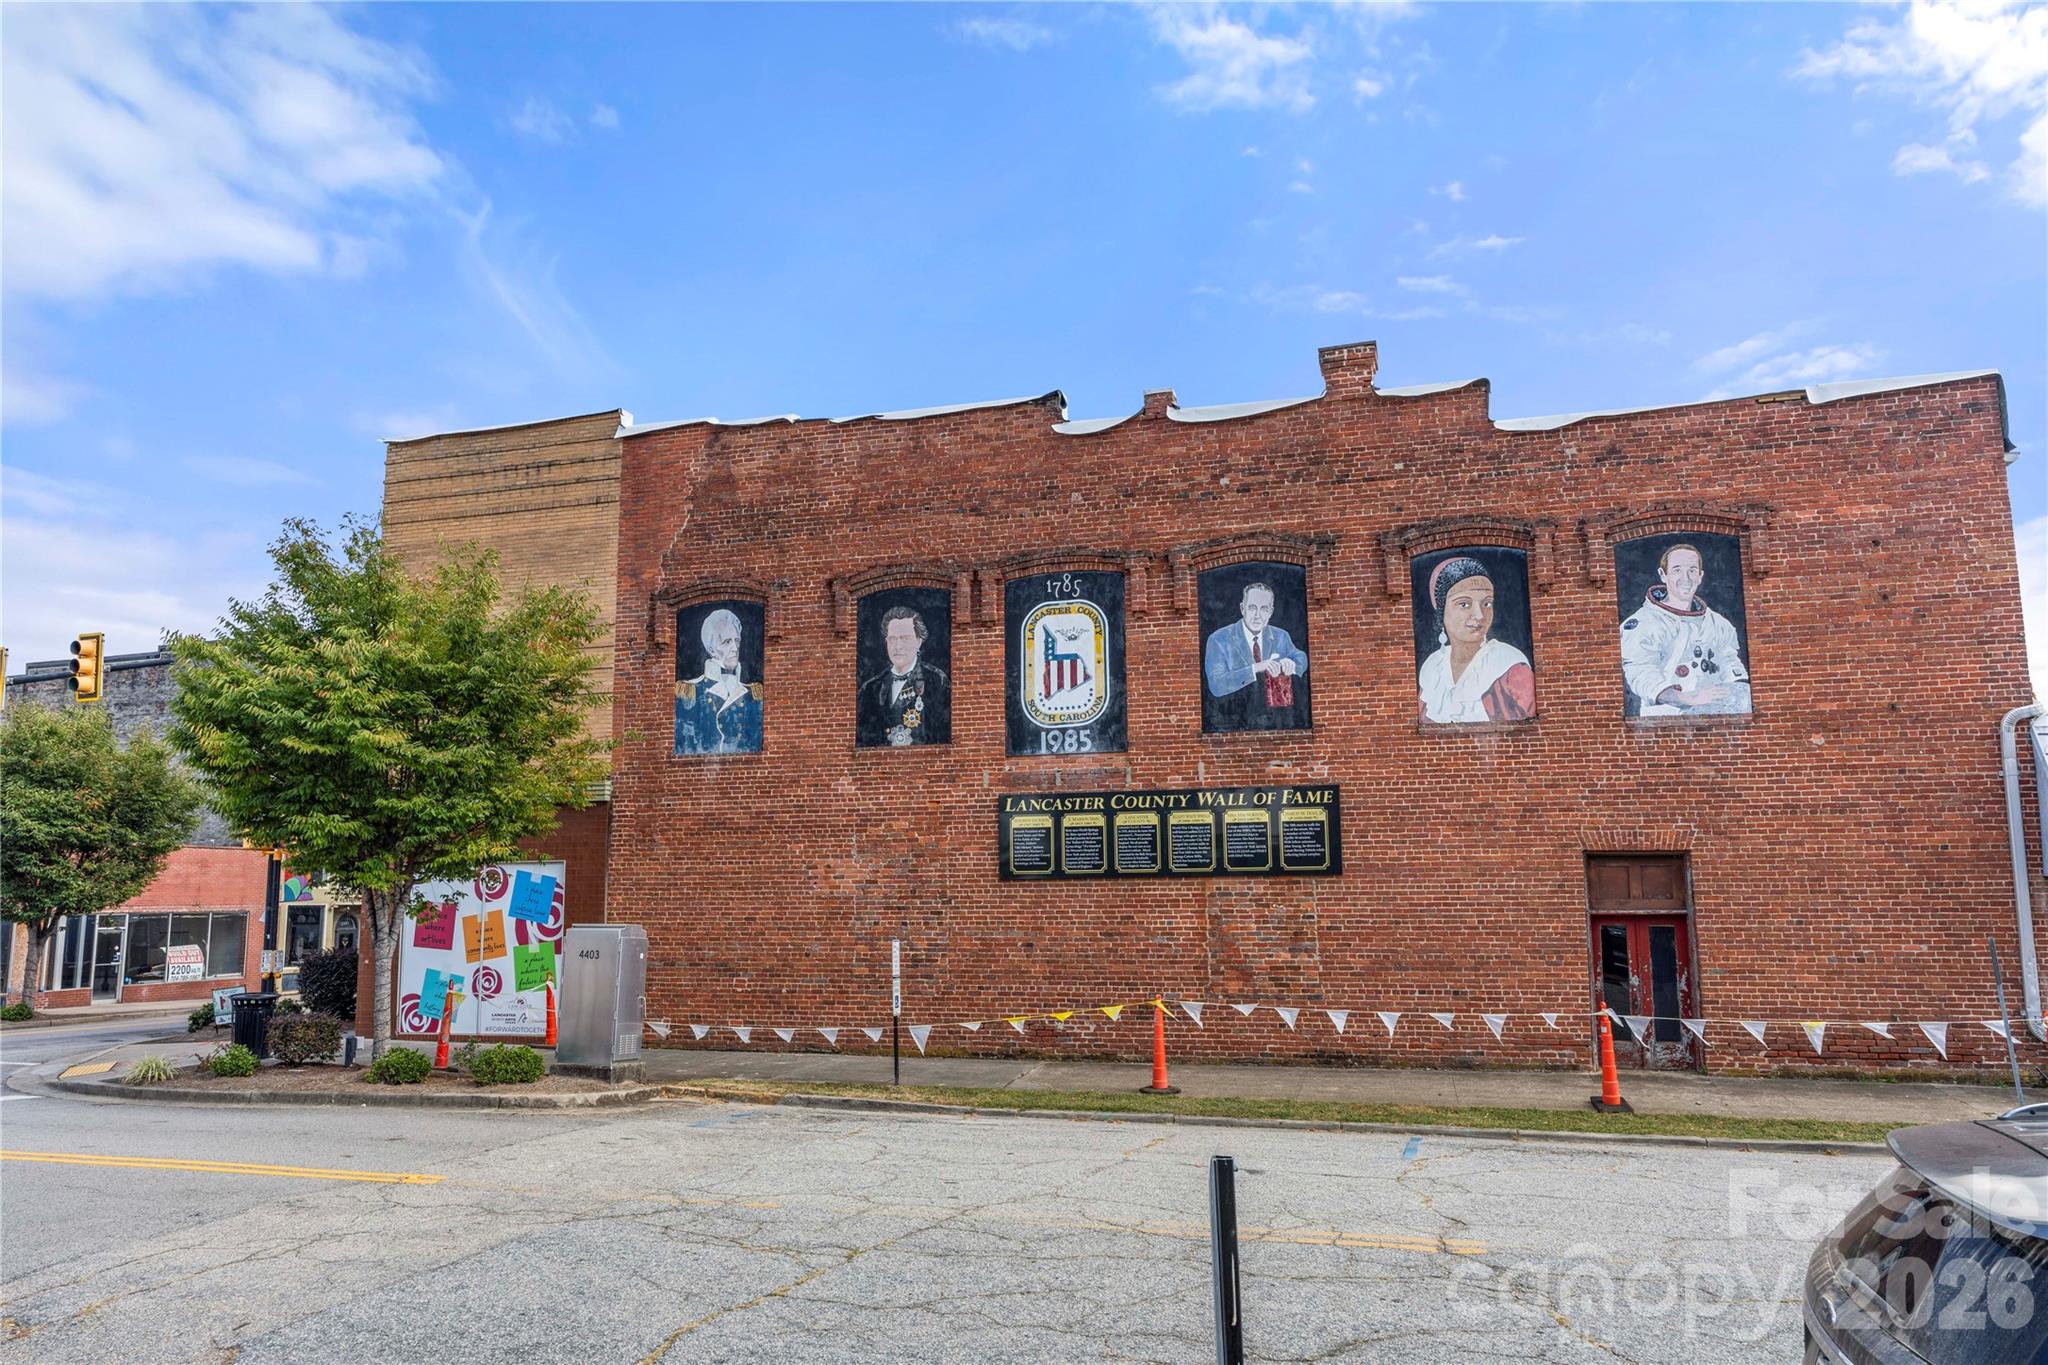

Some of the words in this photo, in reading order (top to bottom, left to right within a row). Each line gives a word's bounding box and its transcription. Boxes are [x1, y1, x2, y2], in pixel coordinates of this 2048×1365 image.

[1046, 573, 1082, 598] 1785
[1028, 607, 1071, 640] LANCASTER
[1077, 607, 1103, 636] COUNTY
[1028, 699, 1056, 722] SOUTH
[1059, 695, 1103, 721] CAROLINA
[1040, 729, 1092, 753] 1985
[1004, 797, 1105, 812] LANCASTER
[1110, 794, 1191, 809] COUNTY
[1197, 792, 1248, 806] WALL
[1253, 792, 1277, 805] OF
[1281, 789, 1334, 805] FAME
[424, 923, 446, 931] where
[579, 950, 600, 960] 4403
[171, 965, 191, 975] 2200
